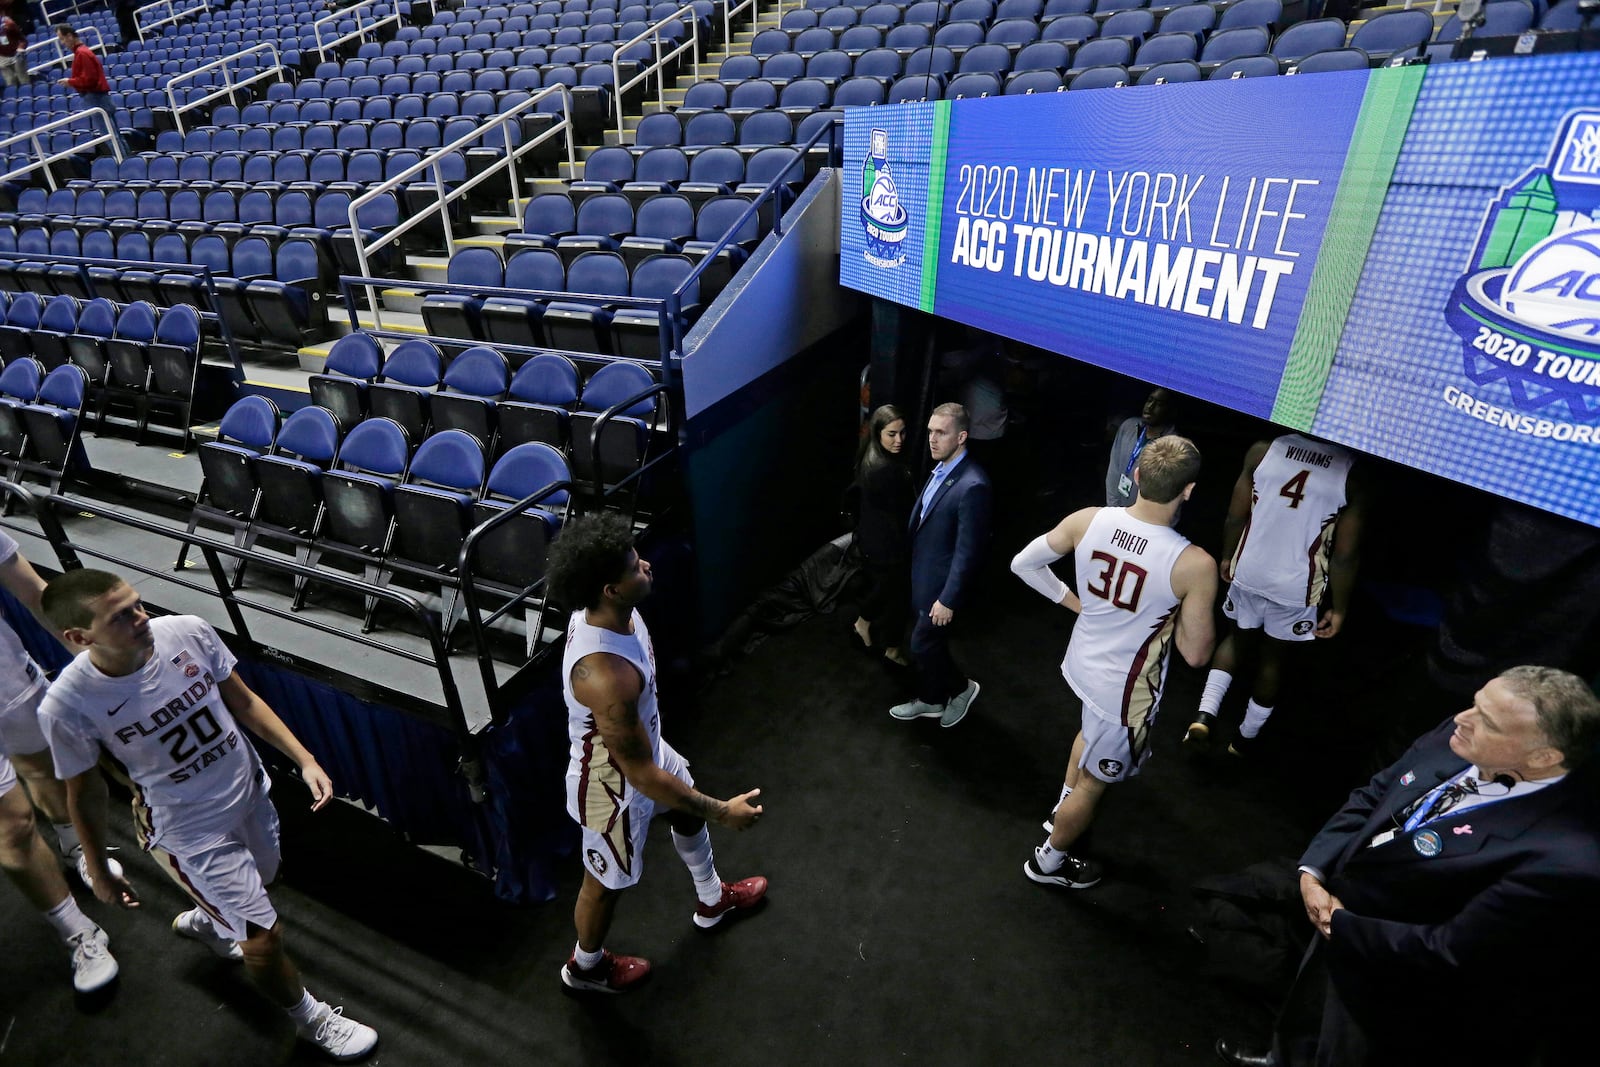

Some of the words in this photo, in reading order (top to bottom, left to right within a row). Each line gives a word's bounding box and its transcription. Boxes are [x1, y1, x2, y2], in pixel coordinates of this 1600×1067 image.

[874, 194, 896, 208] ACC
[956, 164, 1018, 220] 2020
[1023, 167, 1096, 229] NEW
[1106, 170, 1205, 243] YORK
[1209, 175, 1320, 257] LIFE
[952, 216, 1007, 273] ACC
[1013, 223, 1295, 330] TOURNAMENT
[1472, 326, 1532, 367] 2020
[1285, 445, 1333, 469] WILLIAMS
[1280, 469, 1312, 509] 4
[1111, 528, 1149, 556] PRIETO
[1087, 550, 1148, 613] 30
[114, 671, 217, 745] FLORIDA
[159, 705, 223, 764] 20
[168, 731, 238, 784] STATE
